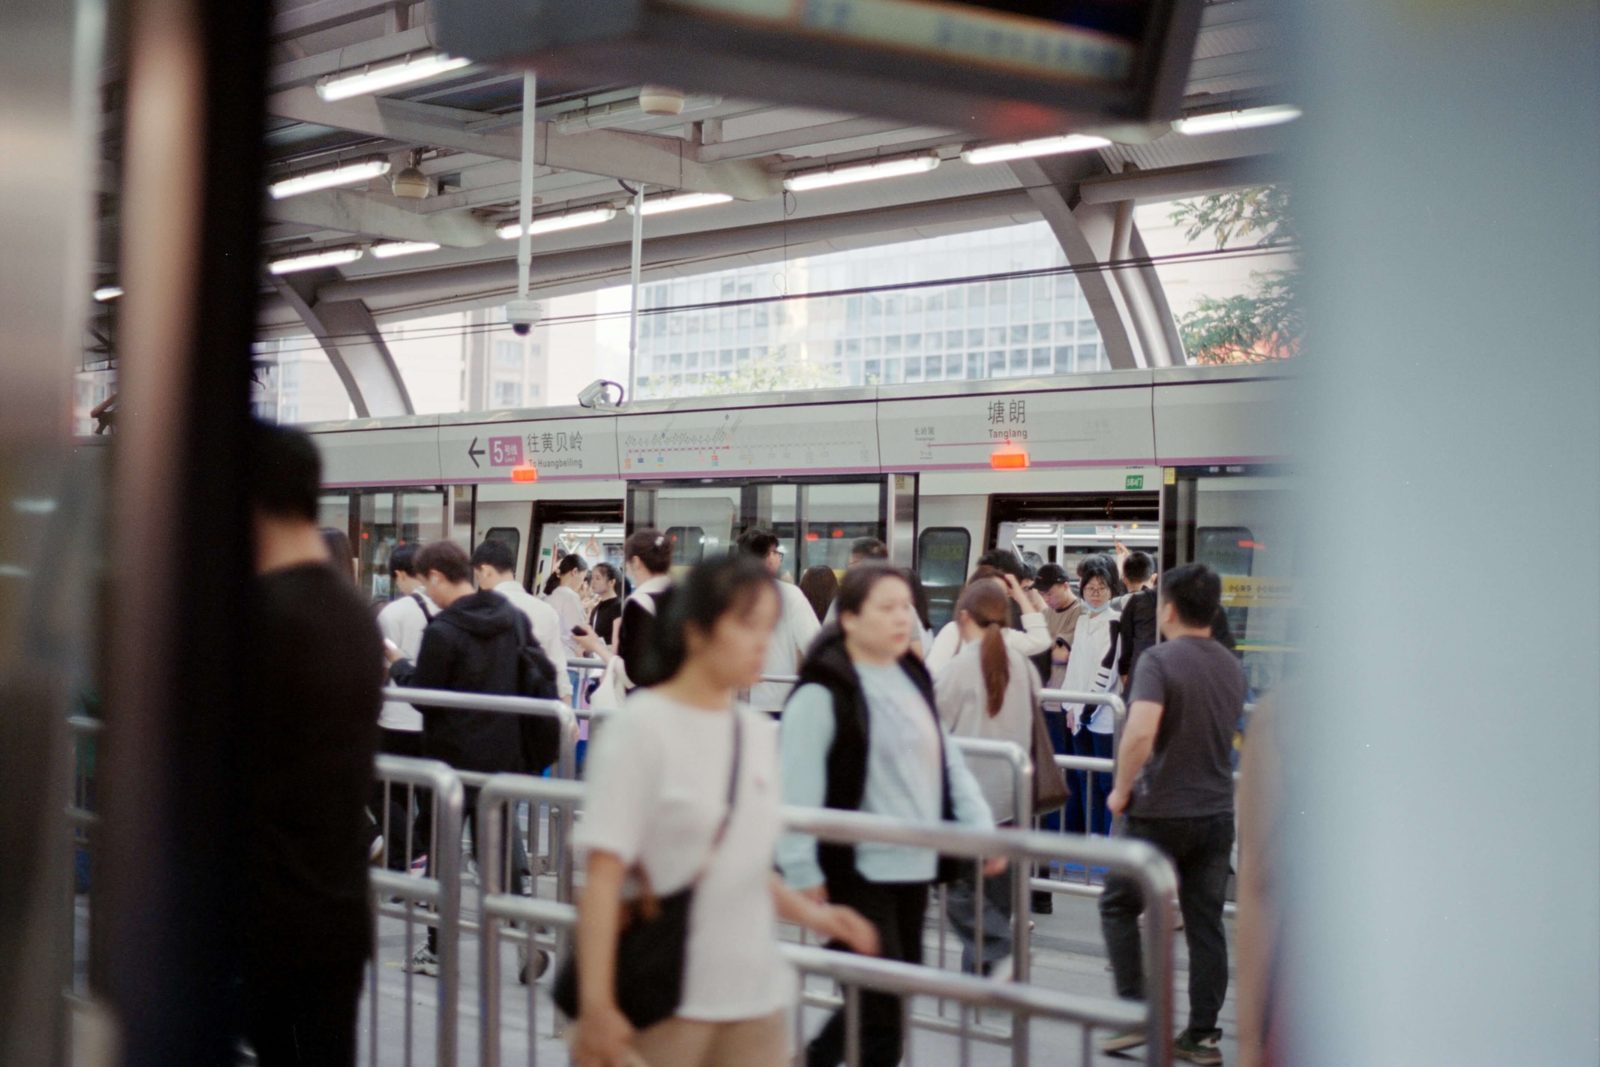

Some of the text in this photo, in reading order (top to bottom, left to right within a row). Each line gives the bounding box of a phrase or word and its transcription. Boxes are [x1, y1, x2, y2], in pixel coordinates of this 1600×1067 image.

[987, 399, 1026, 424] 塘朗
[527, 430, 583, 453] 往黄贝岭
[988, 428, 1028, 440] Tanglang
